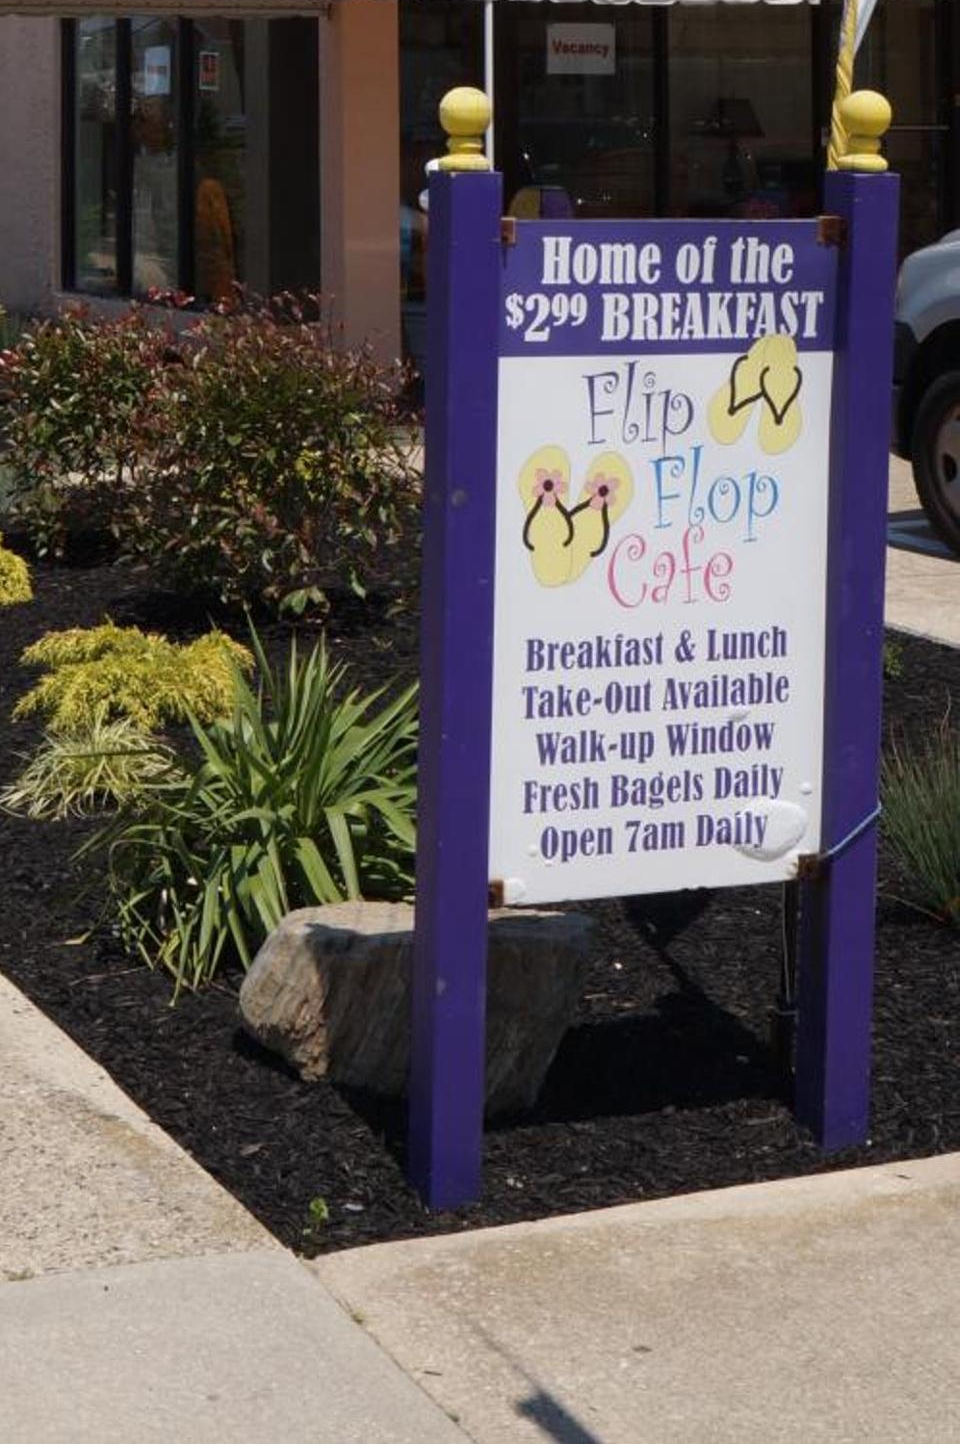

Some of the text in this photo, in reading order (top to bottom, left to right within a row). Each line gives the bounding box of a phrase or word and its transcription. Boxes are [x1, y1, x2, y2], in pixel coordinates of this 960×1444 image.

[551, 38, 610, 58] Vacancy
[541, 235, 795, 285] Home of the
[601, 291, 824, 341] BREAKFAST
[581, 360, 696, 456] Flip
[651, 444, 780, 544] Flop
[605, 524, 735, 609] Cafe
[525, 626, 788, 673] Breakfast & Lunch
[522, 672, 790, 720] Take-Out Available
[536, 721, 776, 766] Walk-up Window
[522, 764, 784, 814] Fresh Bagels Daily
[540, 812, 769, 864] Open 7am Daily
